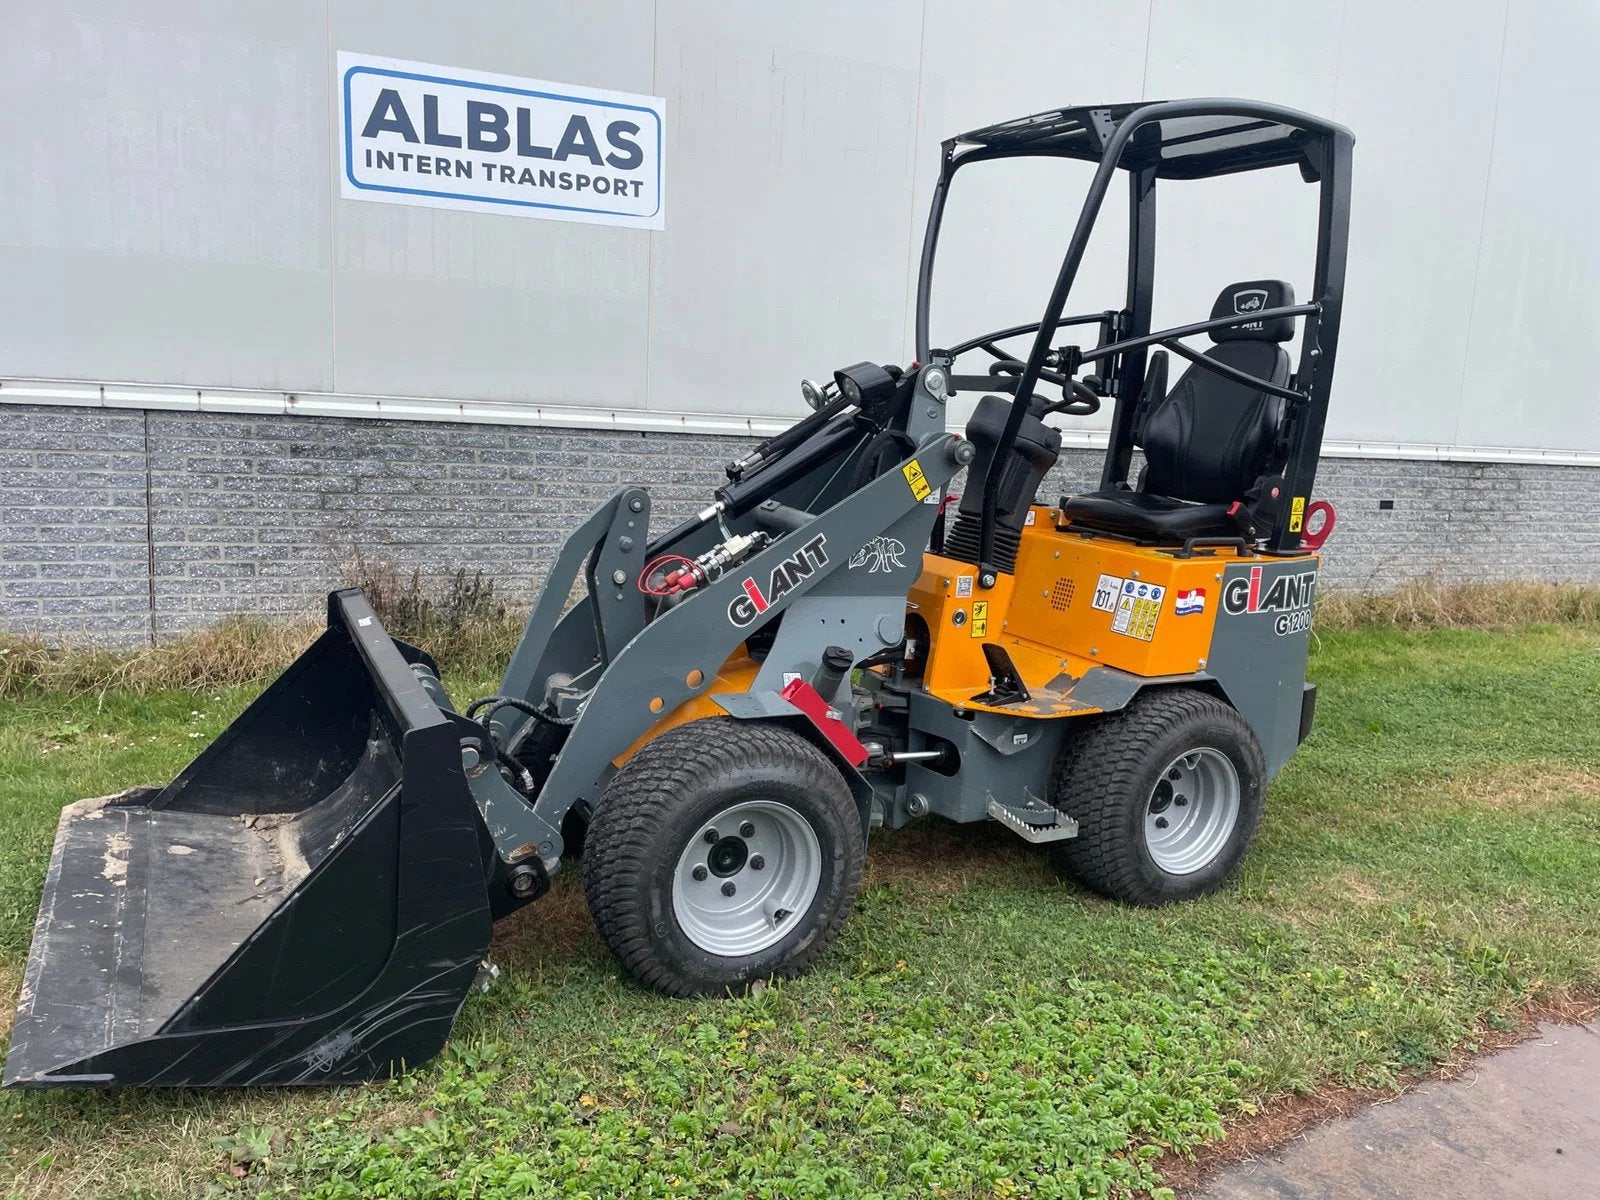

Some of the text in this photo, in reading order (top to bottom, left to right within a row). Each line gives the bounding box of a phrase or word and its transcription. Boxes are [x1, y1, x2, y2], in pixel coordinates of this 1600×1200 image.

[361, 88, 644, 170] ALBLAS
[366, 149, 644, 198] INTERN TRANSPORT
[1094, 589, 1111, 609] 101
[1274, 609, 1311, 636] G1200
